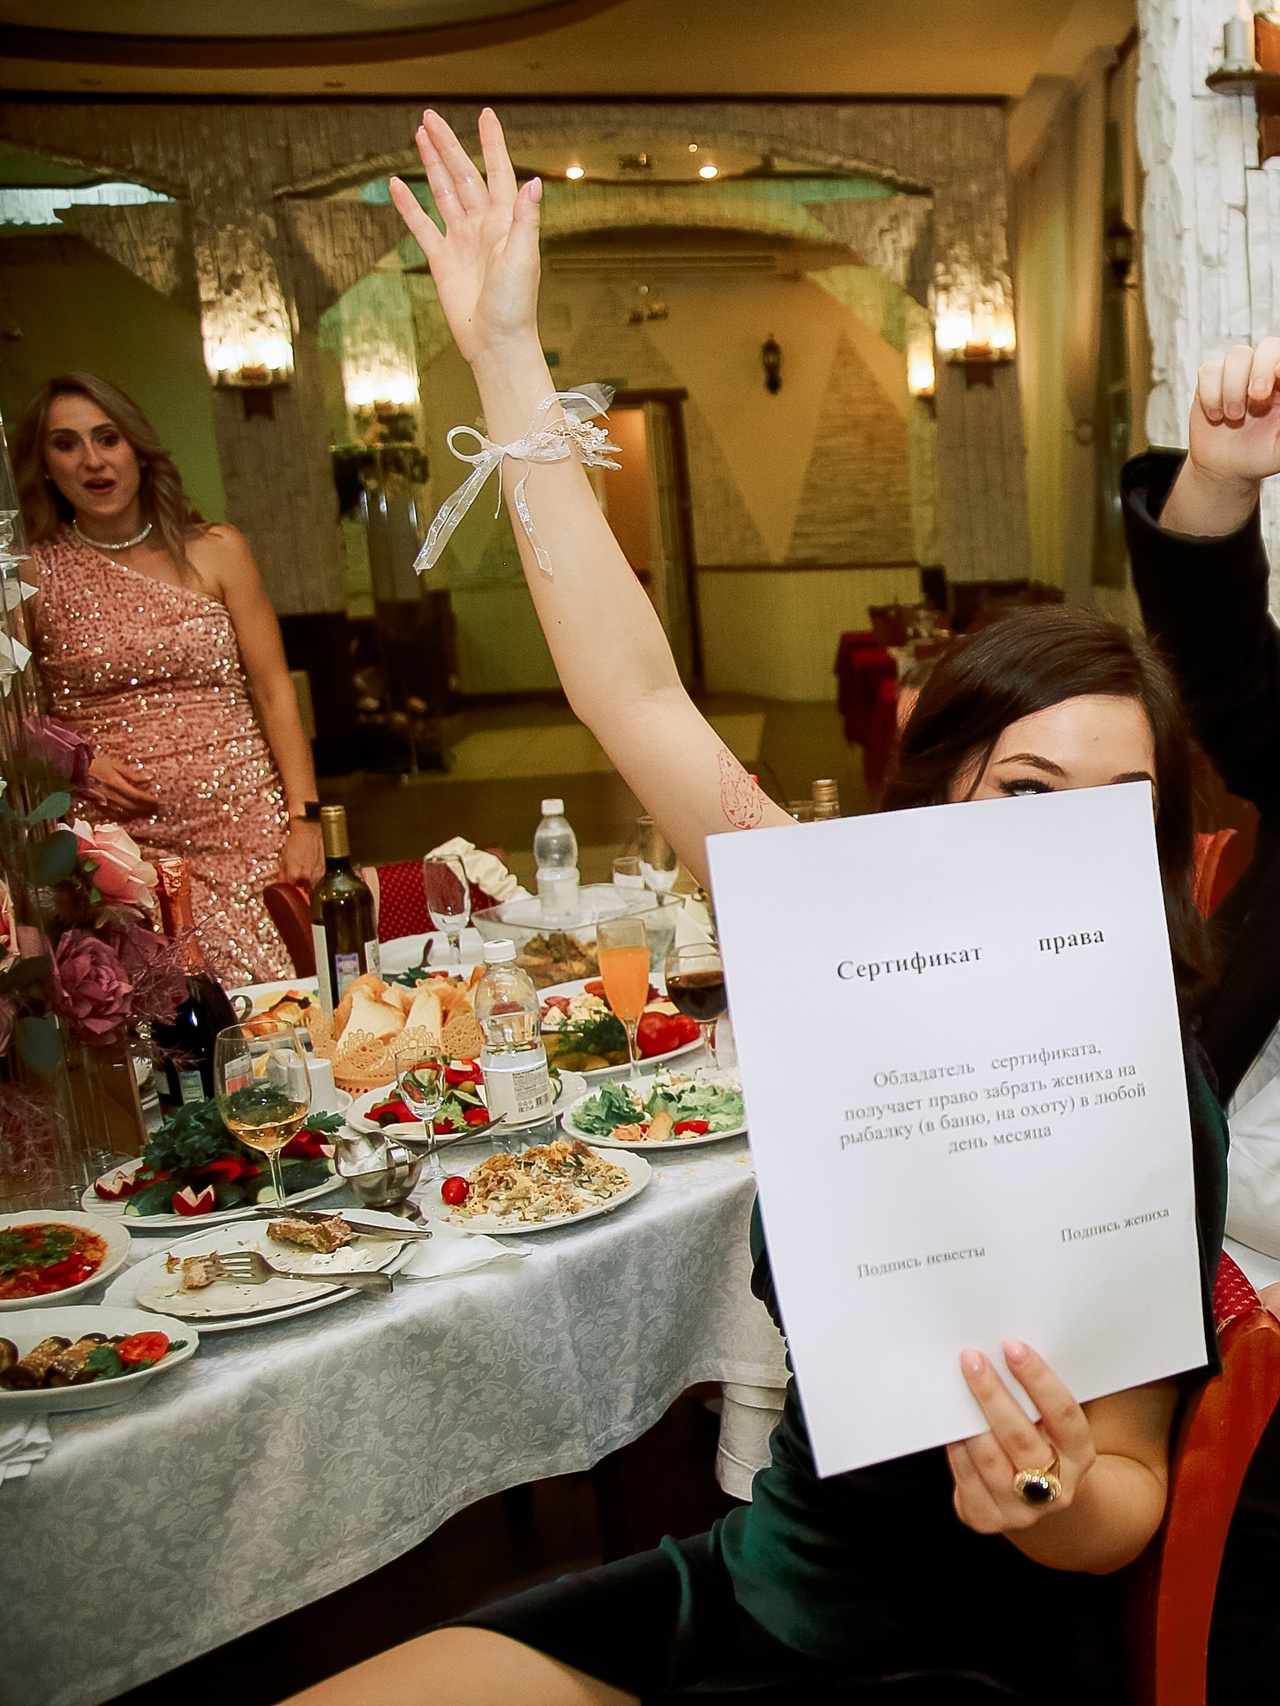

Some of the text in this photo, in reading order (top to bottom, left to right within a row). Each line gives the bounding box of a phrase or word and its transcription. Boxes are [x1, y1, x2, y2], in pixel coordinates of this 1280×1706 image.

[836, 929, 1105, 981] Сертификат права
[873, 1044, 1102, 1087] Обладатель сертификата,
[839, 1081, 1146, 1150] рыбалку (в баню, на охоту) в любой
[844, 1064, 1137, 1124] получает право забрать жениха на
[948, 1126, 1052, 1155] день месяца
[1061, 1208, 1170, 1243] Подпись жениха
[857, 1247, 986, 1279] Подпись невесты
